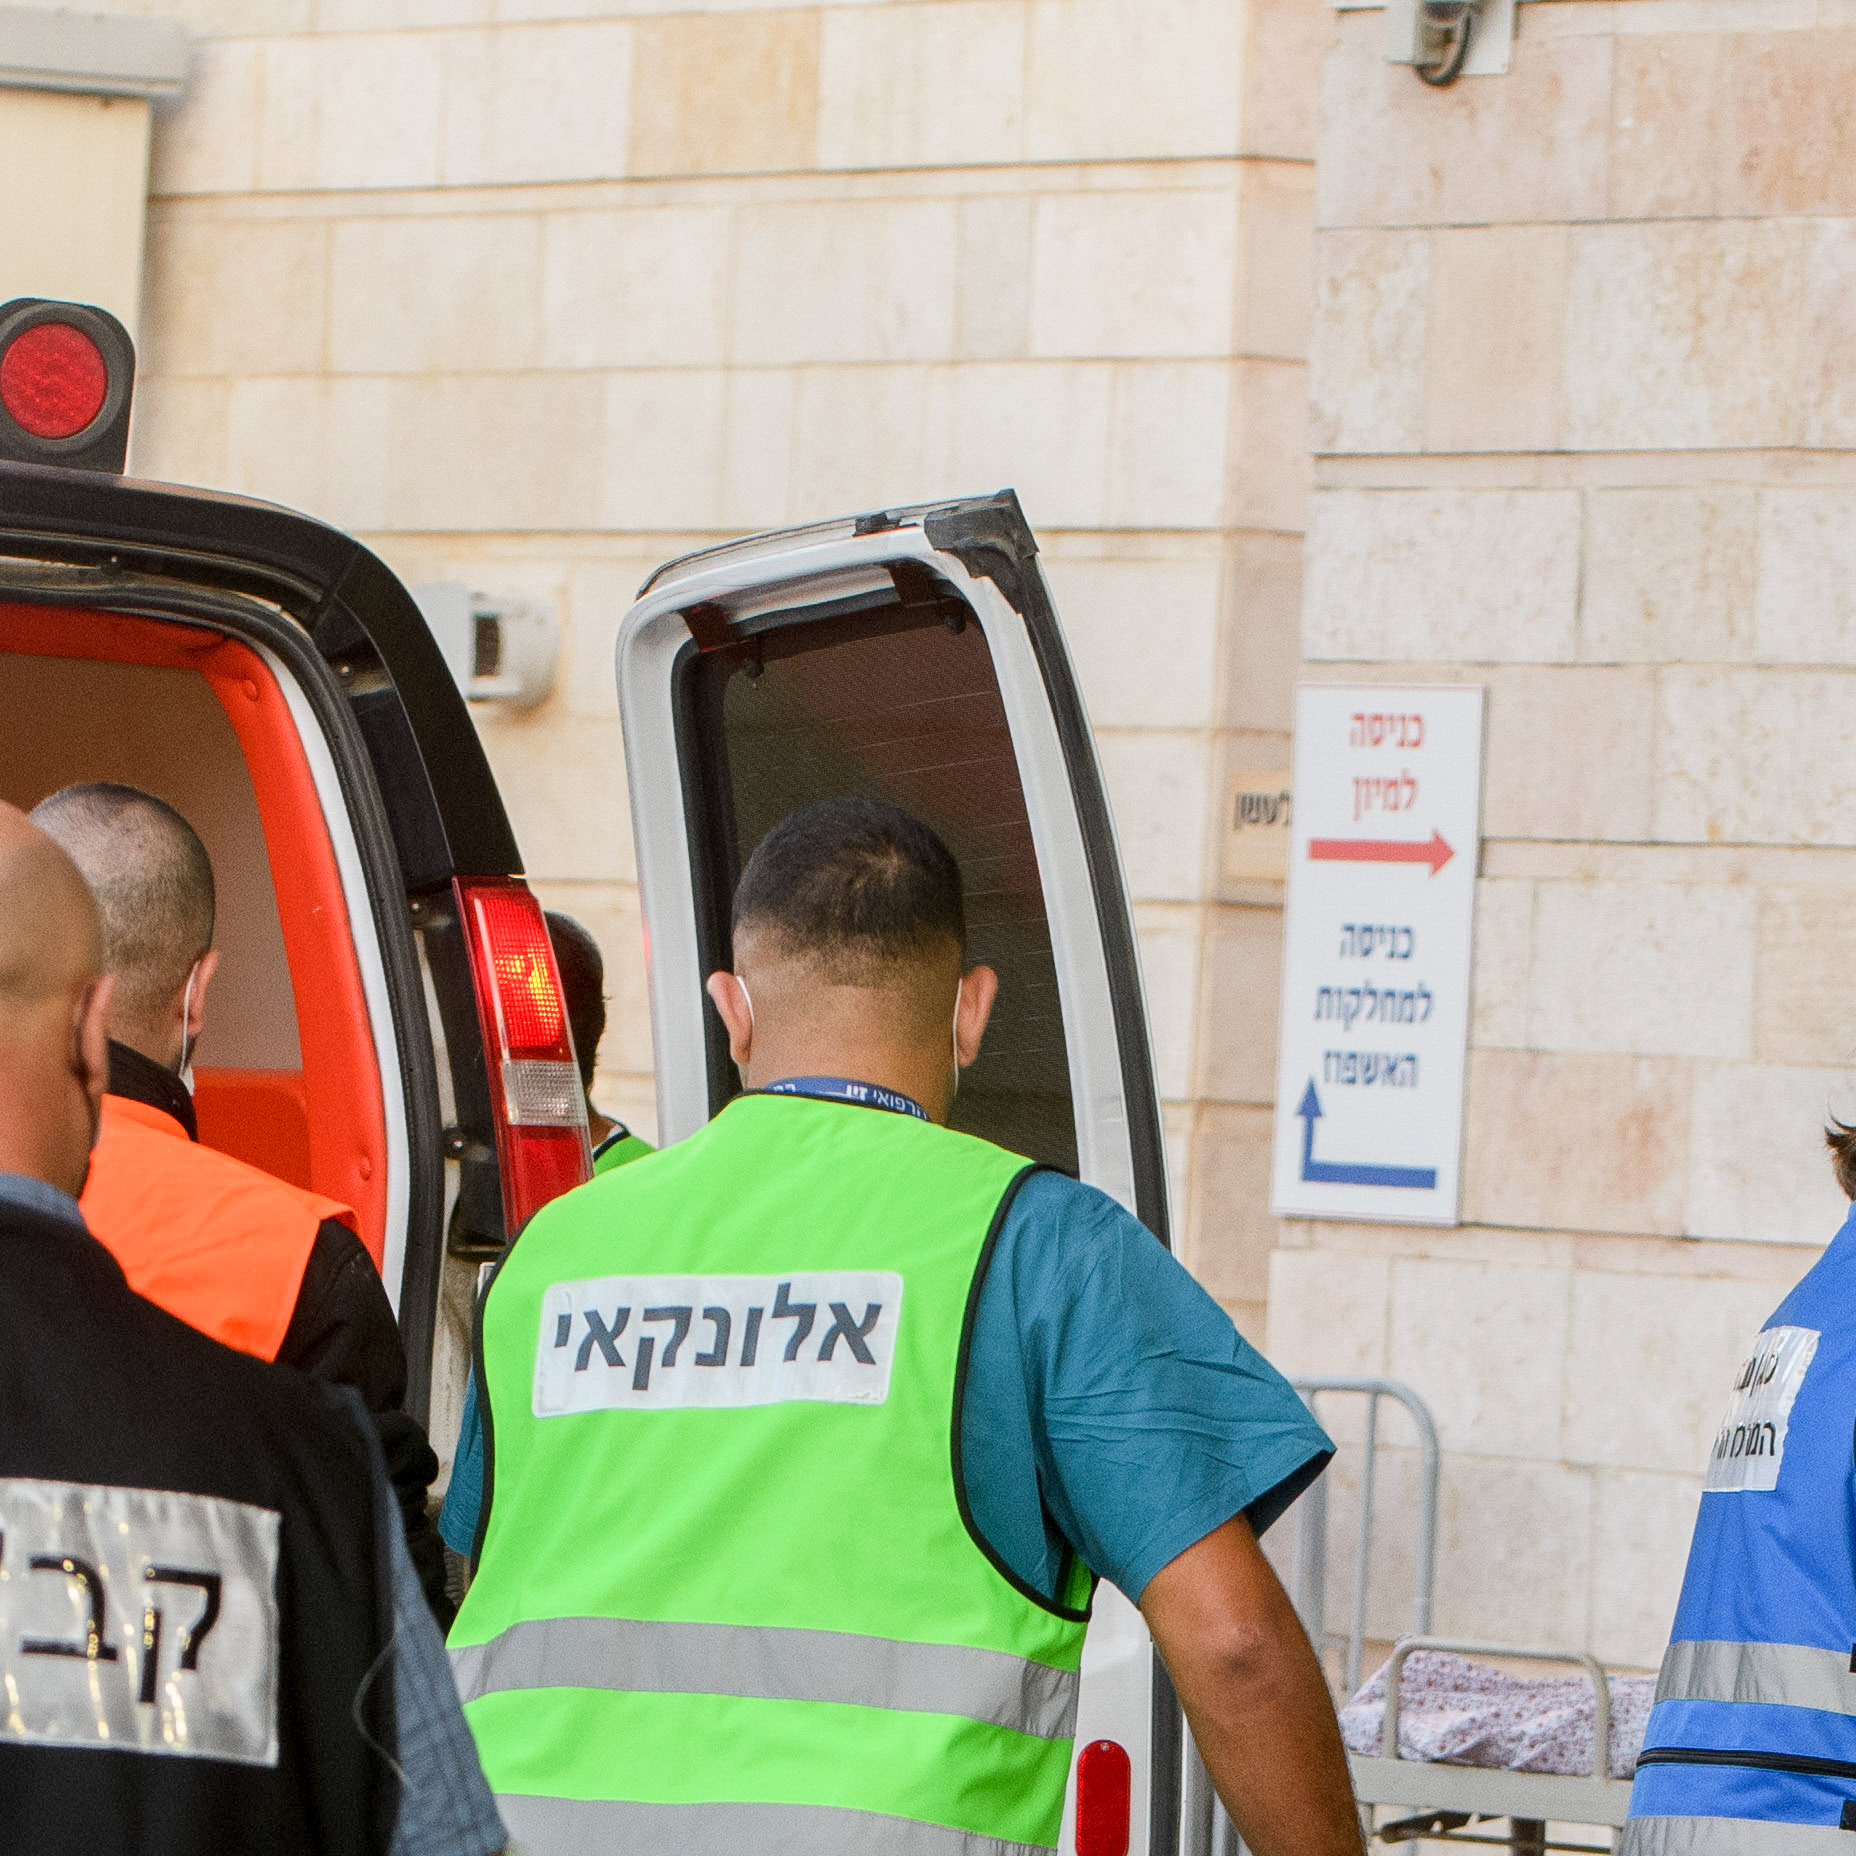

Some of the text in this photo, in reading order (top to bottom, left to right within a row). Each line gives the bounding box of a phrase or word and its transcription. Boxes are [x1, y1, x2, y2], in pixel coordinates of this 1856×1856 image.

[1350, 713, 1424, 749] כניסה
[1352, 768, 1417, 821] למיון
[1340, 923, 1414, 958] כניסה
[1314, 978, 1433, 1031] למחלקות
[1324, 1050, 1417, 1087] האשפוז
[554, 1281, 883, 1391] אלונקאי
